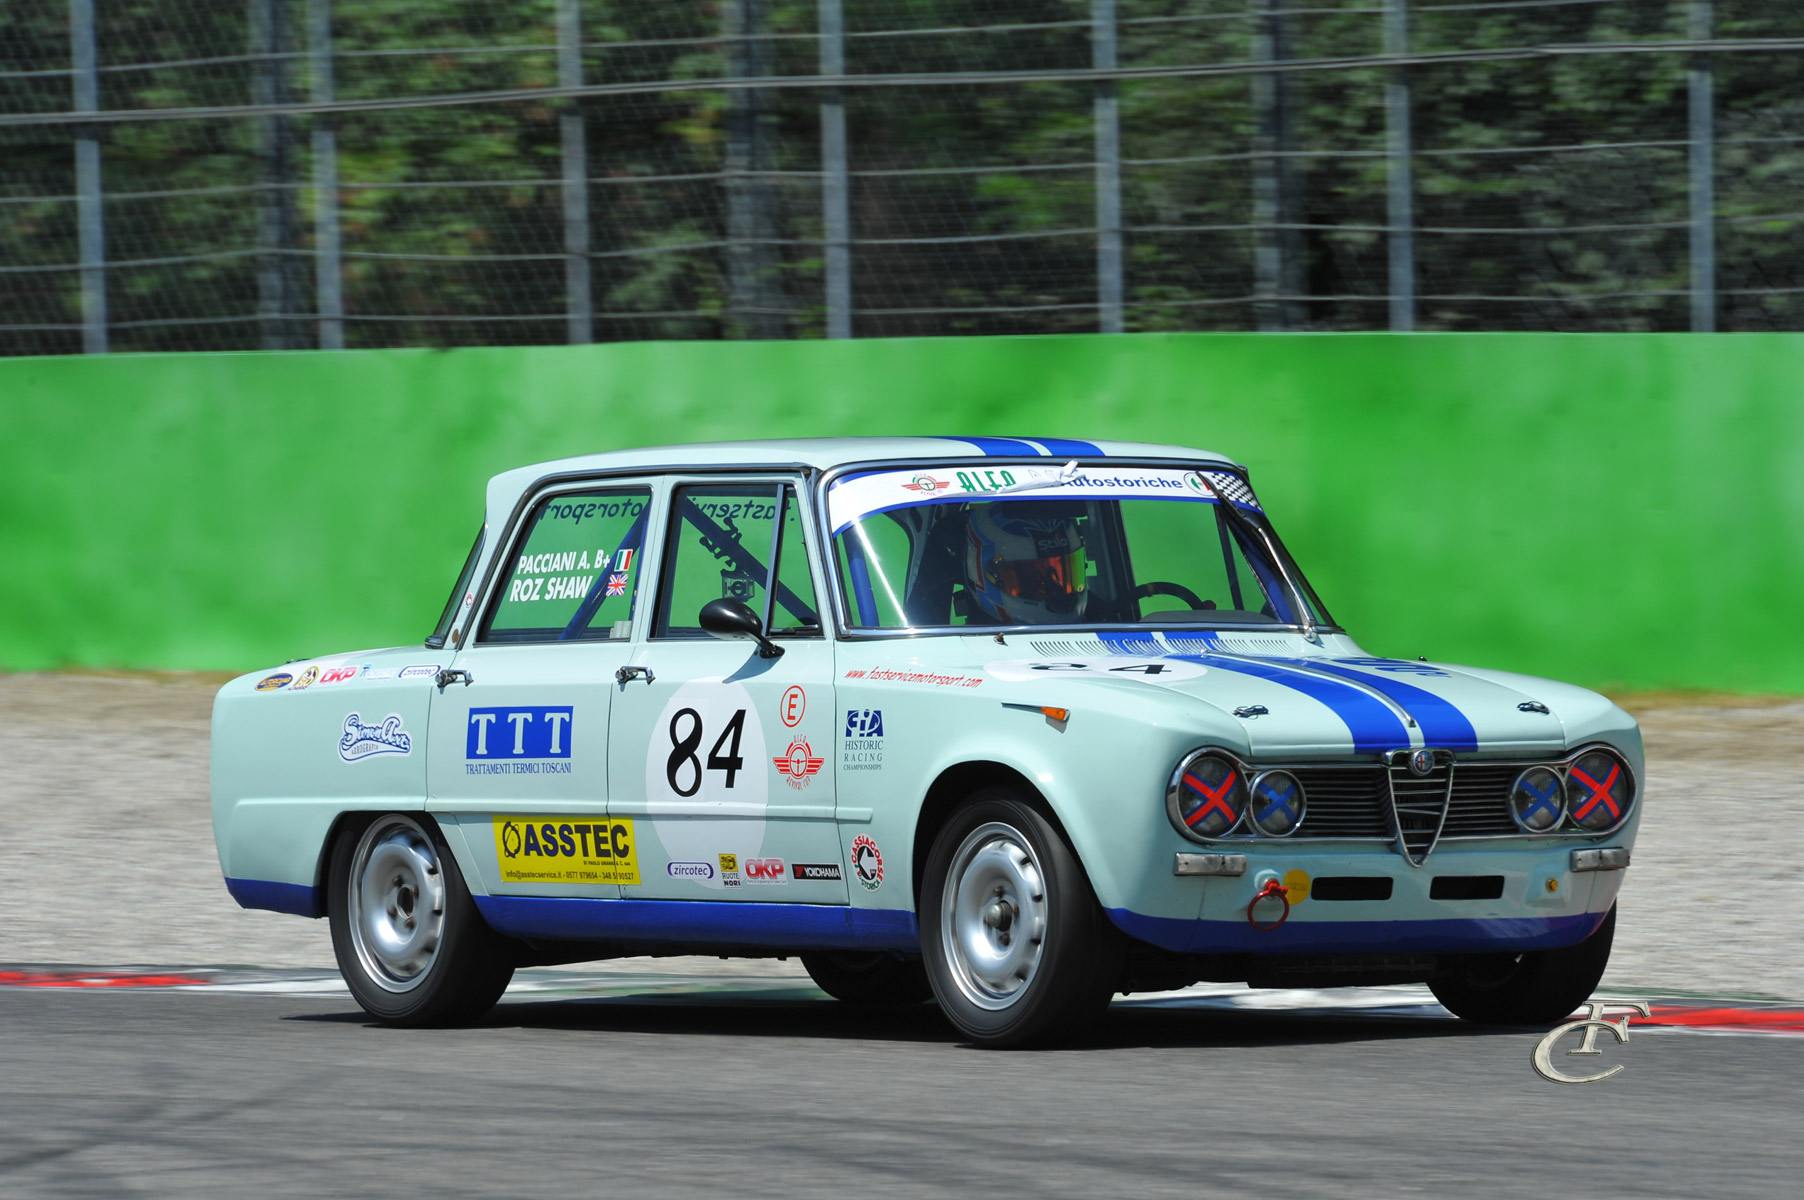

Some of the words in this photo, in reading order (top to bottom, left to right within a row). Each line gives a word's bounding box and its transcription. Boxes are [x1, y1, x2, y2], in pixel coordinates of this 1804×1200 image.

[517, 551, 577, 575] PACCIANI
[577, 550, 591, 570] A.
[510, 578, 545, 602] ROZ
[544, 575, 593, 600] SHAW
[787, 693, 799, 721] E
[667, 707, 746, 797] 84
[844, 740, 884, 751] HISTORIC
[844, 752, 883, 762] RACING
[465, 763, 511, 775] TRATTAMENTI
[512, 762, 540, 774] TERMICI
[541, 762, 572, 774] TOSCANI
[843, 763, 882, 771] CHAMPIONSHIPS
[524, 823, 630, 859] ASSTEC
[673, 864, 708, 877] zircotec
[745, 858, 785, 879] OKP
[804, 866, 841, 878] YOKOHAMA
[566, 871, 578, 880] 0577
[722, 872, 740, 880] RUOTE
